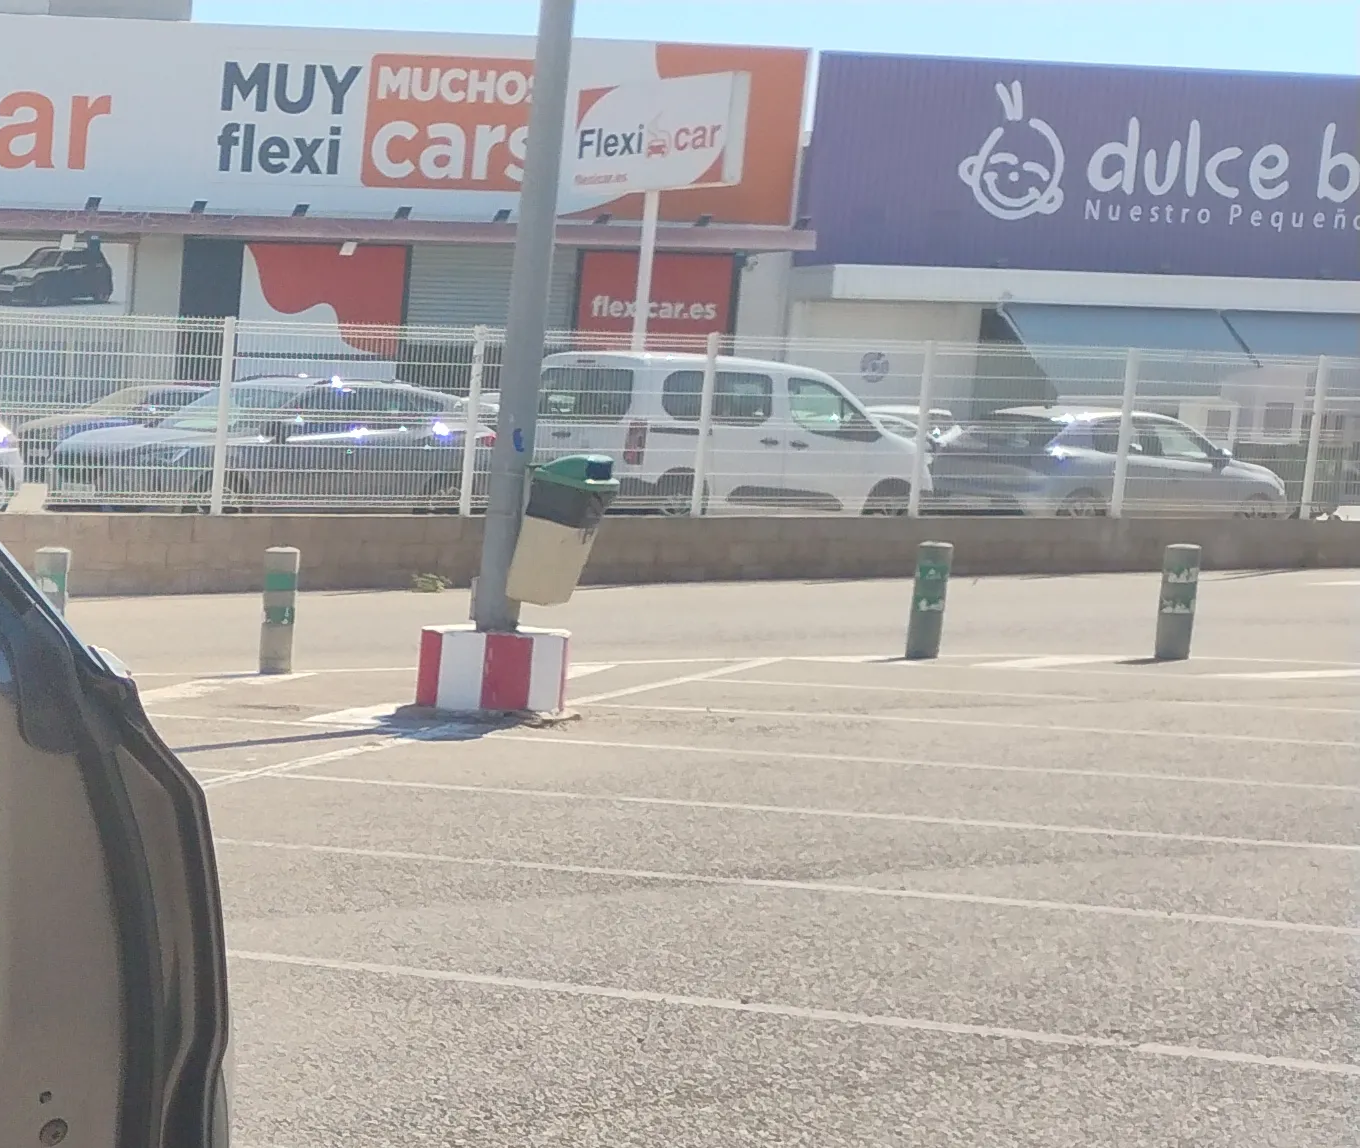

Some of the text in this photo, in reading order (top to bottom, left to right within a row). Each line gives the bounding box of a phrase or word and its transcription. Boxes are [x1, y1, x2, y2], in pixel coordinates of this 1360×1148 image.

[220, 61, 363, 116] MUY
[377, 65, 534, 105] MUCHO
[217, 122, 342, 176] flexi
[1086, 115, 1290, 200] dulce
[1085, 198, 1211, 225] Nuestro
[591, 295, 718, 321] flexcar.es
